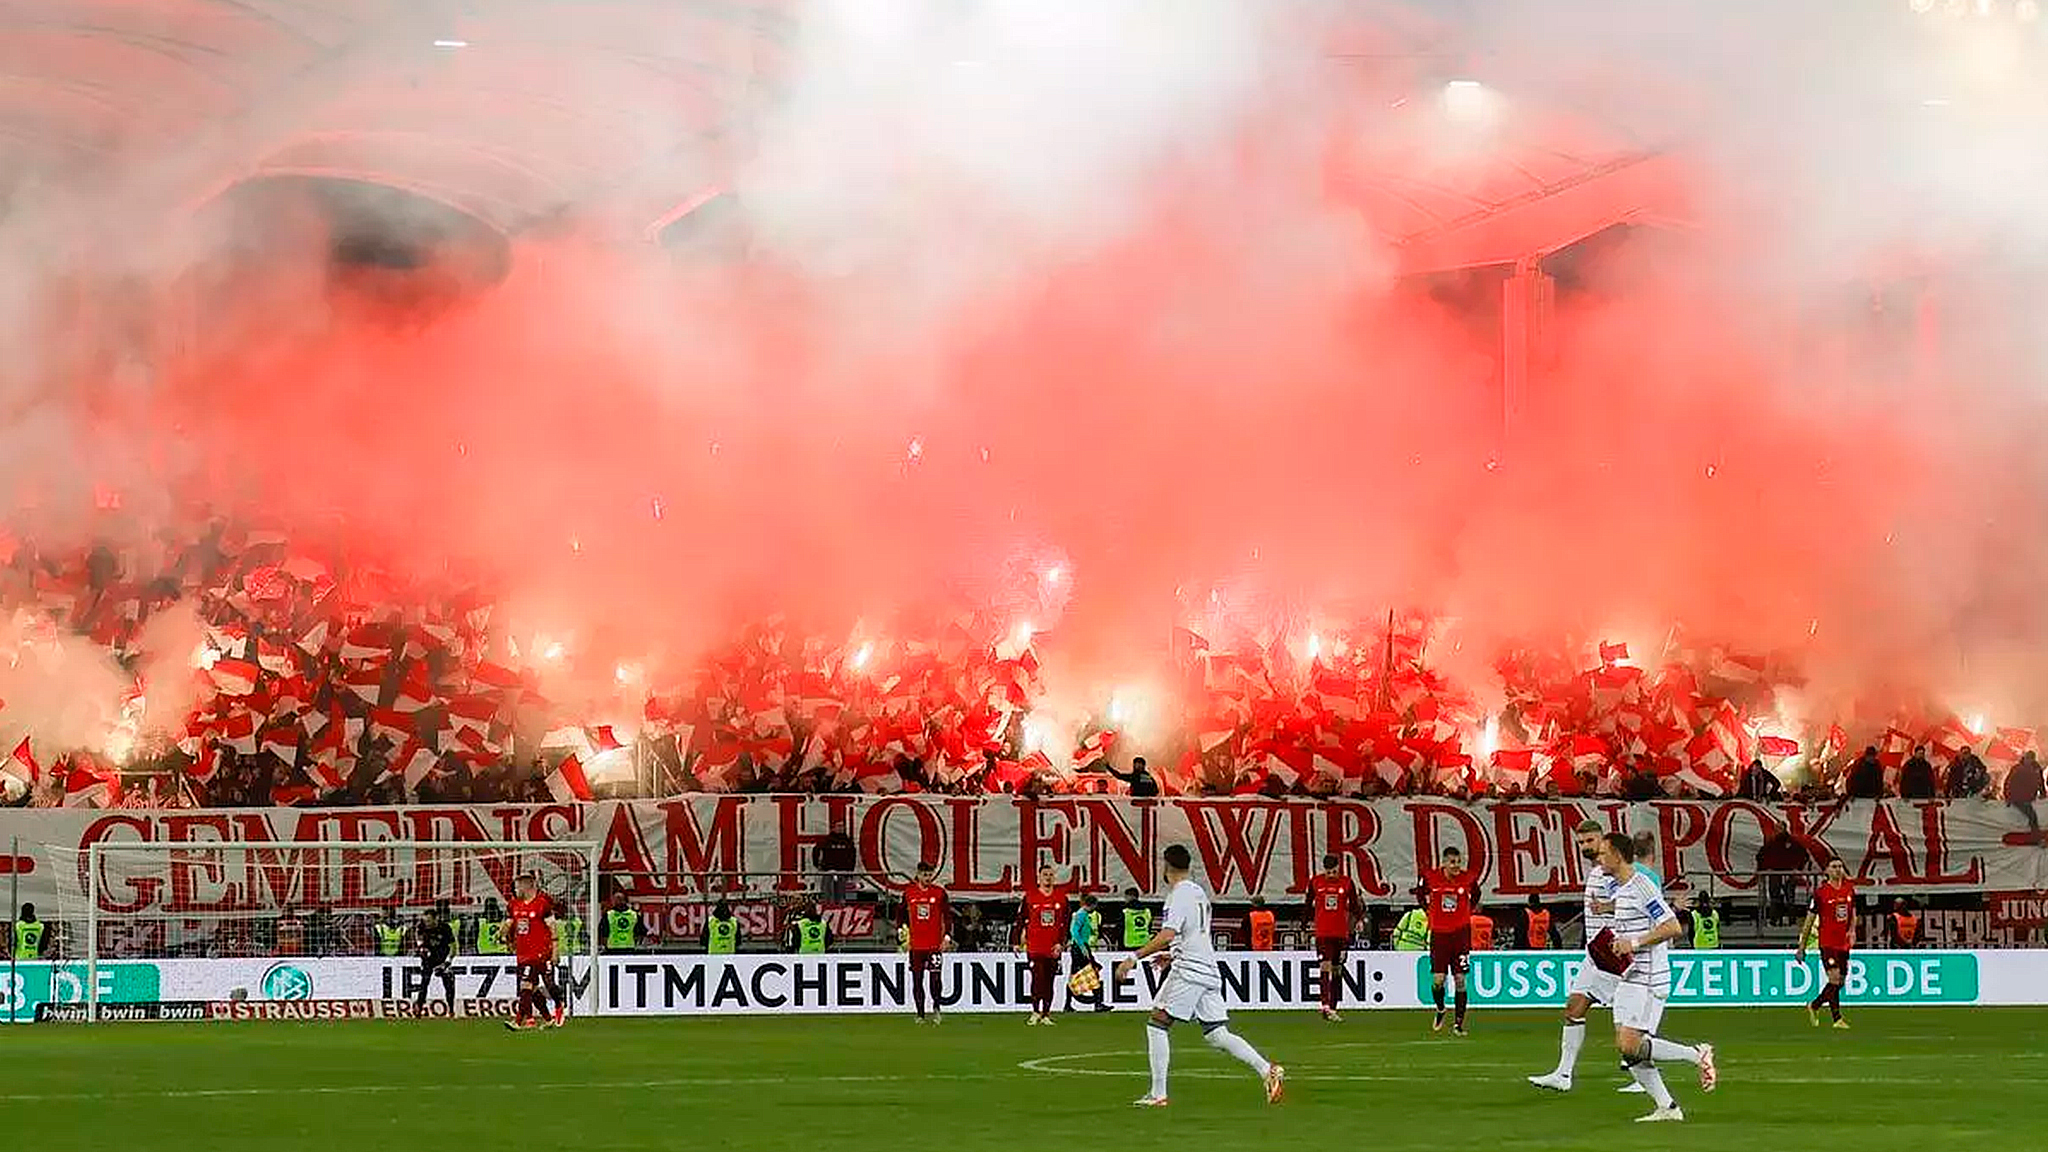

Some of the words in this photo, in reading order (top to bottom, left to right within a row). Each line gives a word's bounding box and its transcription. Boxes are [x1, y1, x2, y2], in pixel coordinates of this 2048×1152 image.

[78, 797, 753, 913] GEMEINSAM
[769, 796, 1159, 893] HOLEN
[1176, 800, 1396, 896] WIR
[1650, 801, 1985, 890] POKAL
[102, 1006, 146, 1020] bwin
[159, 1004, 204, 1020] bwin
[235, 1002, 346, 1020] STRAUSS
